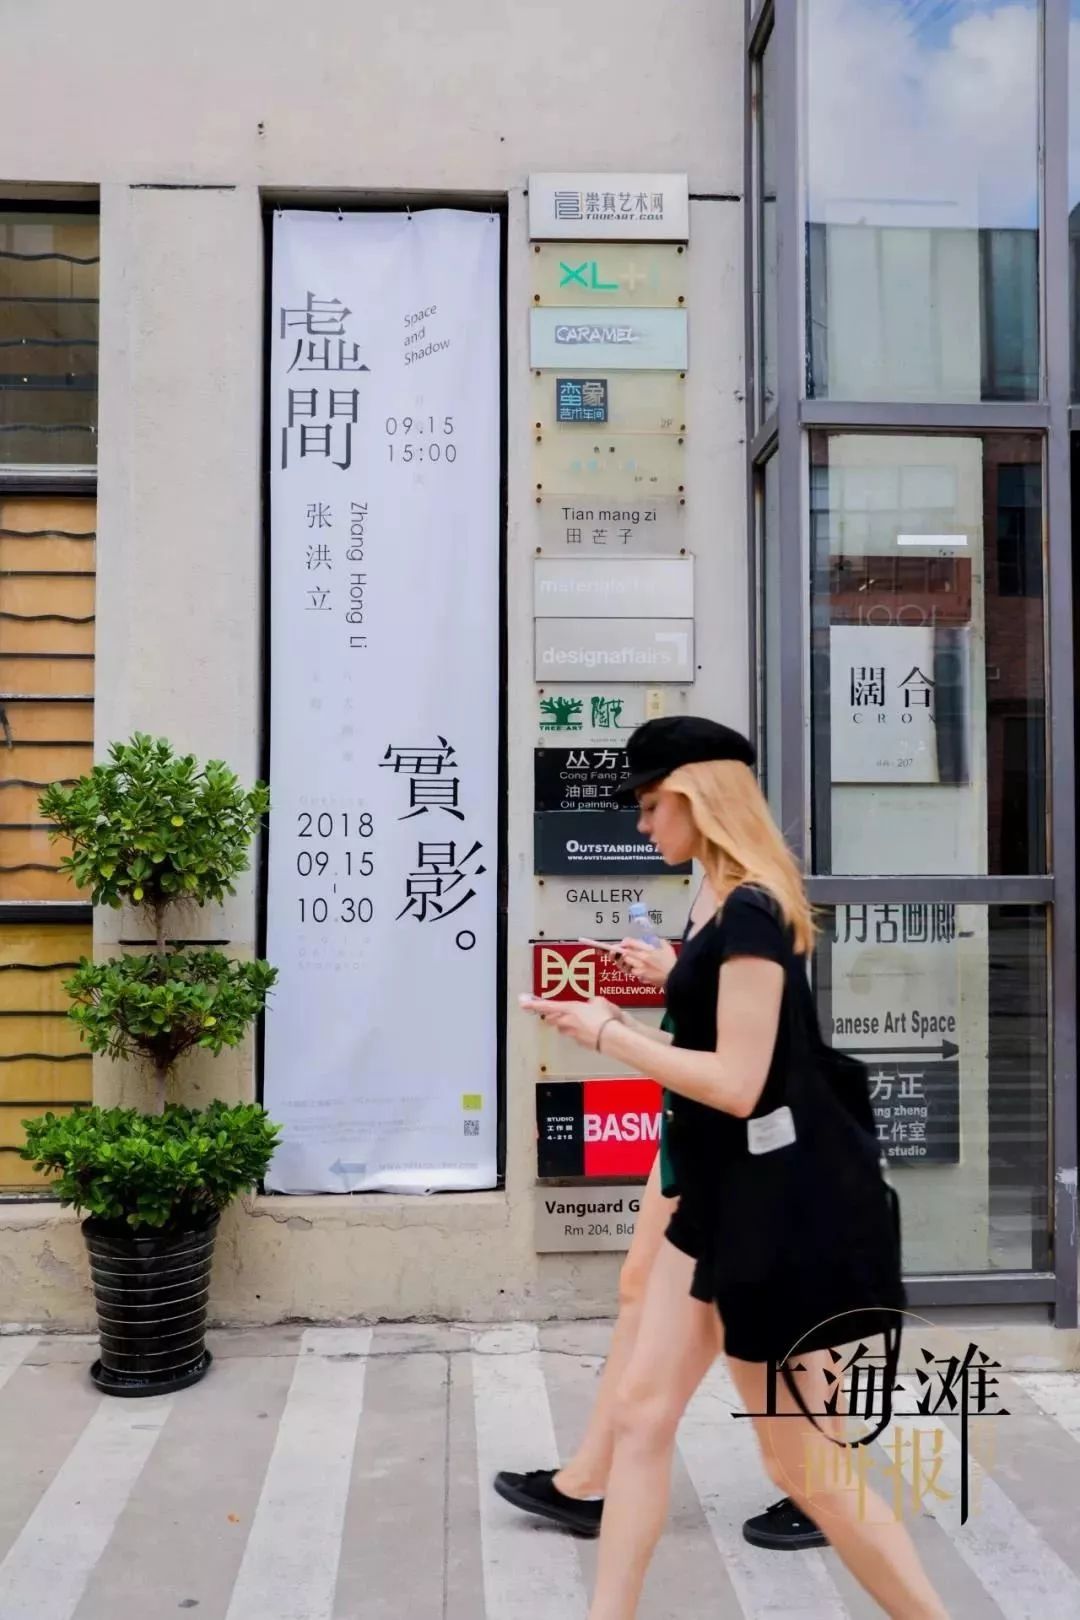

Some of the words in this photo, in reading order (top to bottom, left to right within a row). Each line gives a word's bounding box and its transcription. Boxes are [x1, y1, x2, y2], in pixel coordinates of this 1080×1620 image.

[403, 304, 437, 328] Space
[403, 325, 425, 346] and
[556, 326, 639, 342] CARAMEL
[404, 339, 451, 365] Shadow
[385, 417, 455, 435] 09.15
[387, 444, 457, 463] 15:00
[562, 507, 594, 521] Tian
[599, 510, 640, 525] mang
[644, 508, 657, 521] zi
[346, 502, 368, 561] Zhang
[567, 528, 633, 545] 田芒子
[304, 502, 333, 610] 张洪立
[346, 573, 367, 624] Hong
[350, 636, 367, 648] Li
[560, 771, 588, 781] Cong
[591, 771, 617, 780] Fang
[560, 801, 575, 809] Oil
[578, 801, 619, 810] painting
[297, 812, 374, 838] 2018
[296, 851, 374, 876] 09.15
[566, 889, 644, 903] GALLERY
[298, 897, 373, 922] 10.30
[600, 986, 656, 995] NEEDLEWORK
[884, 1011, 907, 1033] Art
[911, 1010, 956, 1039] Space
[867, 1072, 925, 1100] 方正
[894, 1105, 927, 1118] zheng
[875, 1121, 926, 1142] 工作室
[888, 1146, 927, 1156] studio
[545, 1199, 623, 1217] Vanguard
[564, 1224, 584, 1236] Rm
[588, 1224, 612, 1236] 204,
[616, 1223, 634, 1235] Bld
